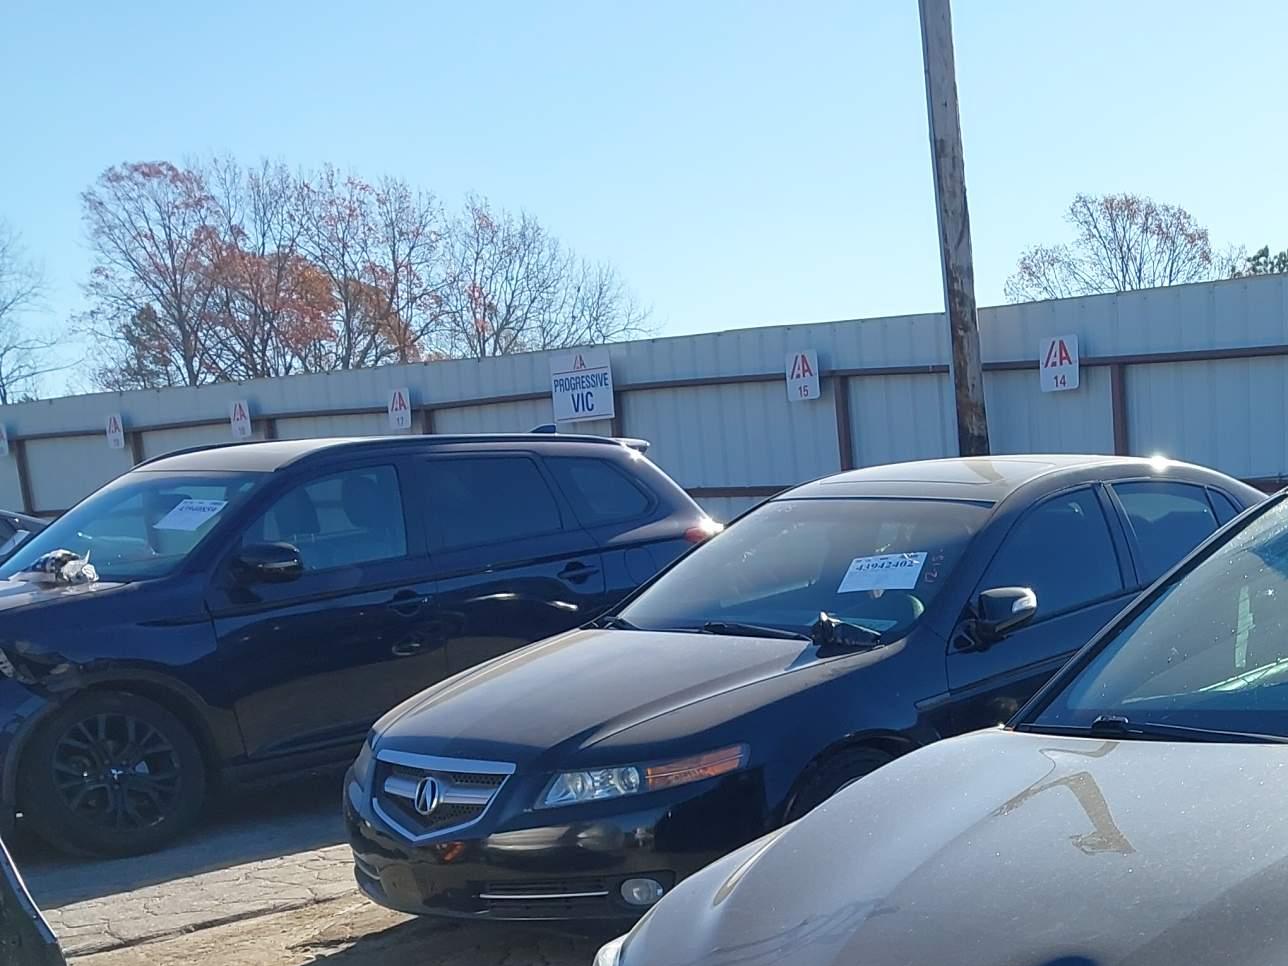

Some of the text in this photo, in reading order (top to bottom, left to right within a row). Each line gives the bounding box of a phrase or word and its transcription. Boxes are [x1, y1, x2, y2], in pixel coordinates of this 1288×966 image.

[553, 372, 609, 393] PROGRESSIVE
[1053, 374, 1066, 388] 14
[799, 385, 809, 398] 15
[571, 391, 595, 413] VIC
